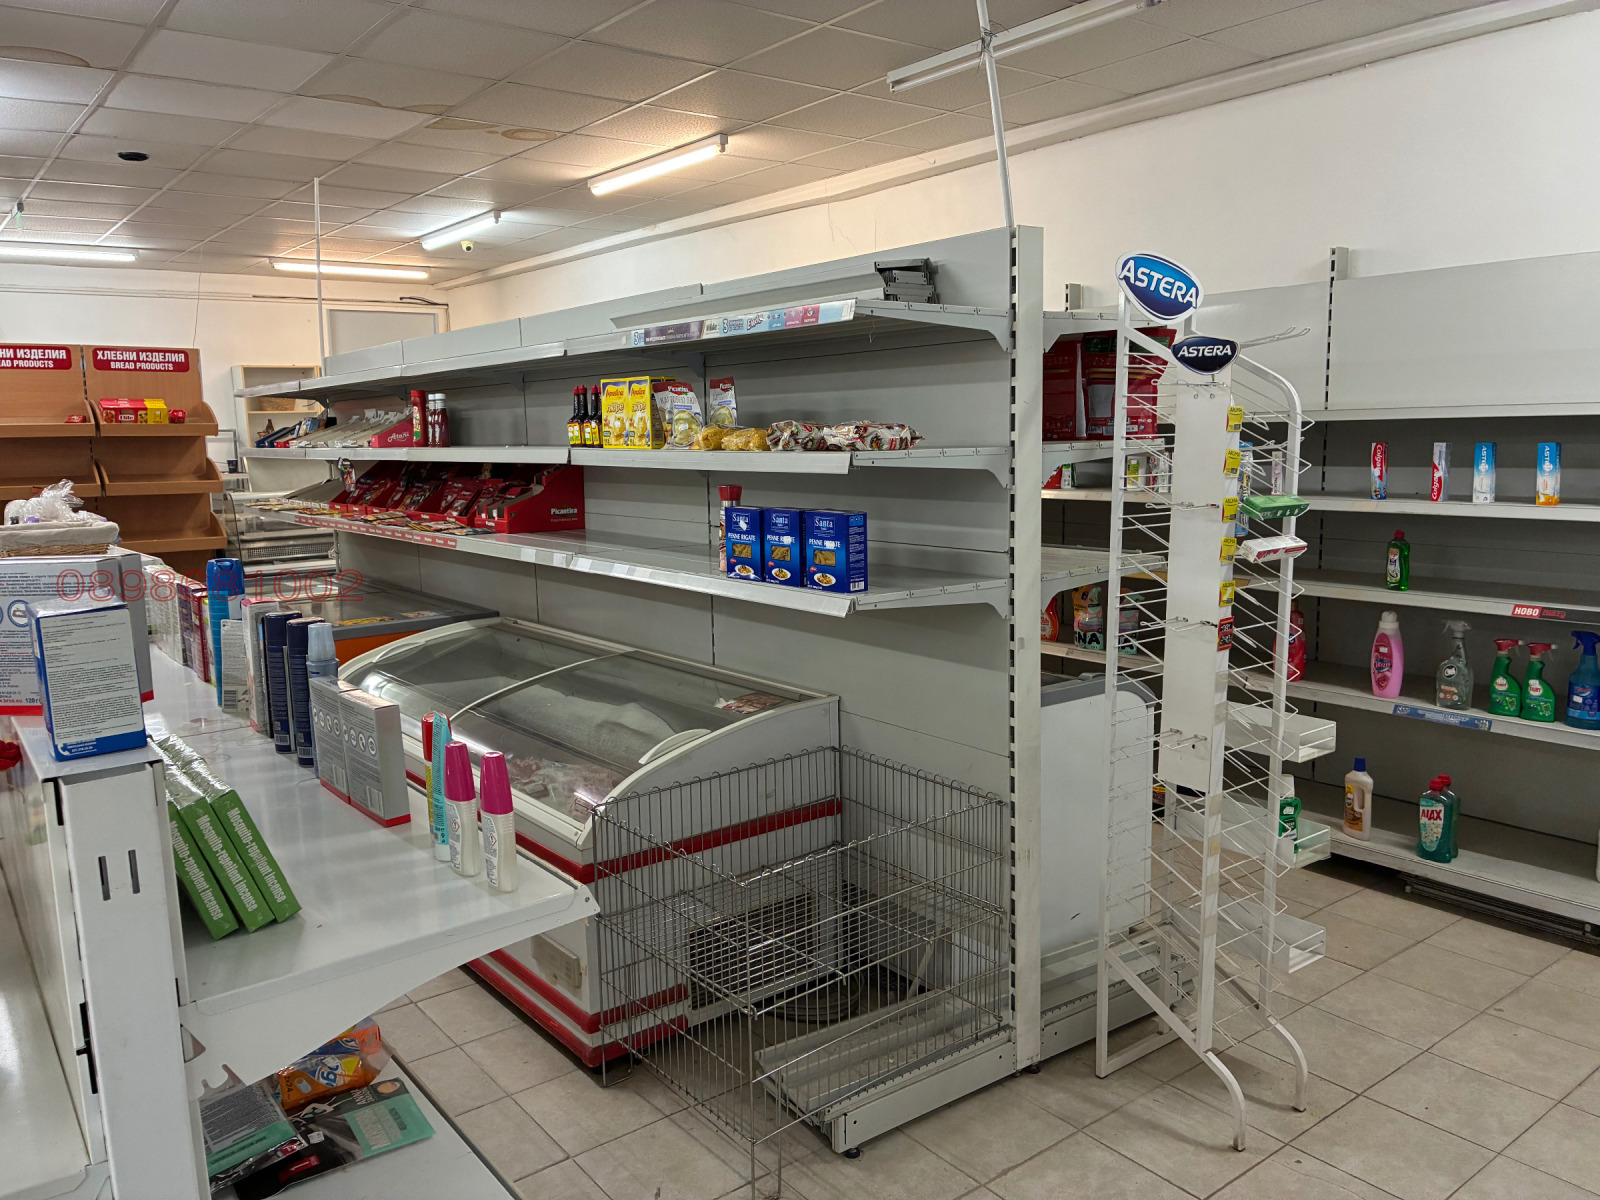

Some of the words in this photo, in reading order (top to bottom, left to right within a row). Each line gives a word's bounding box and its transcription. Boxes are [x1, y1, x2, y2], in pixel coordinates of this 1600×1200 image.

[1118, 259, 1199, 309] ASTERA
[0, 348, 14, 359] НИ
[16, 349, 67, 360] ИЗДЕЛИЯ
[96, 350, 137, 361] ХЛЕБНИ
[139, 351, 185, 363] ИЗДЕЛИЯ
[1177, 344, 1232, 358] ASTERA
[13, 360, 54, 368] PRODUCTS
[110, 361, 135, 370] BREAD
[136, 362, 174, 371] PRODUCTS
[771, 514, 788, 524] Santa
[814, 517, 833, 528] Santa
[728, 532, 740, 540] PENNE
[741, 533, 756, 542] RIGATE
[767, 534, 779, 542] PENNE
[808, 538, 823, 546] PENNE
[227, 807, 273, 876] Mosquito-repellent
[263, 871, 287, 903] incense
[195, 814, 243, 886] Mosquito-repellent
[234, 879, 258, 912] incense
[170, 820, 210, 893] Mosquito-repellent
[199, 888, 224, 921] incense
